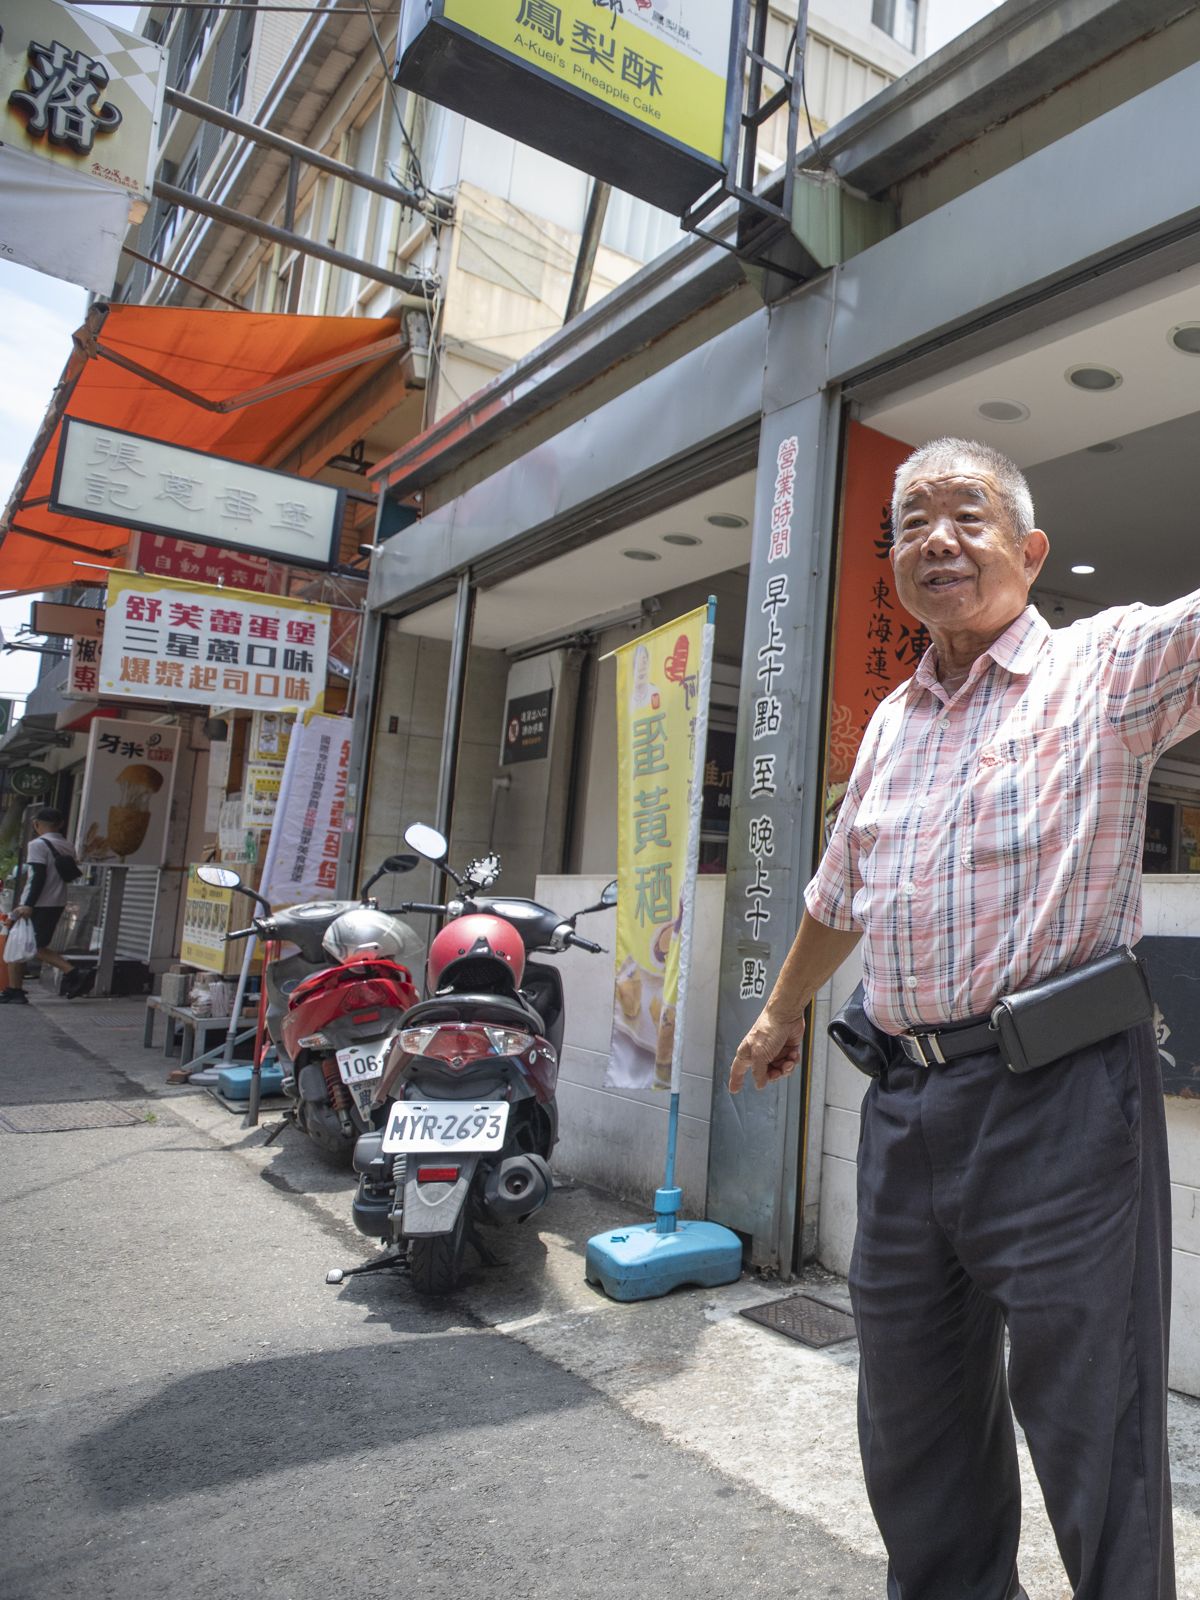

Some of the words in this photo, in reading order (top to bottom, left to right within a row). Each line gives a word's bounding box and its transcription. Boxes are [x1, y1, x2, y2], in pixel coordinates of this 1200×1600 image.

[513, 33, 567, 69] A-Kuei's
[572, 63, 630, 103] Pineapple
[632, 96, 662, 120] Cake
[515, 0, 664, 97] 鳳梨酥
[85, 436, 147, 513] 張記
[768, 437, 798, 561] 營業時間
[122, 626, 314, 673] 三星蔥口味
[126, 595, 316, 646] 舒芙蕾蛋堡
[754, 576, 788, 738] 早上十點
[119, 655, 311, 700] 爆漿起司口味
[751, 755, 776, 798] 至
[740, 817, 774, 999] 晚上十點
